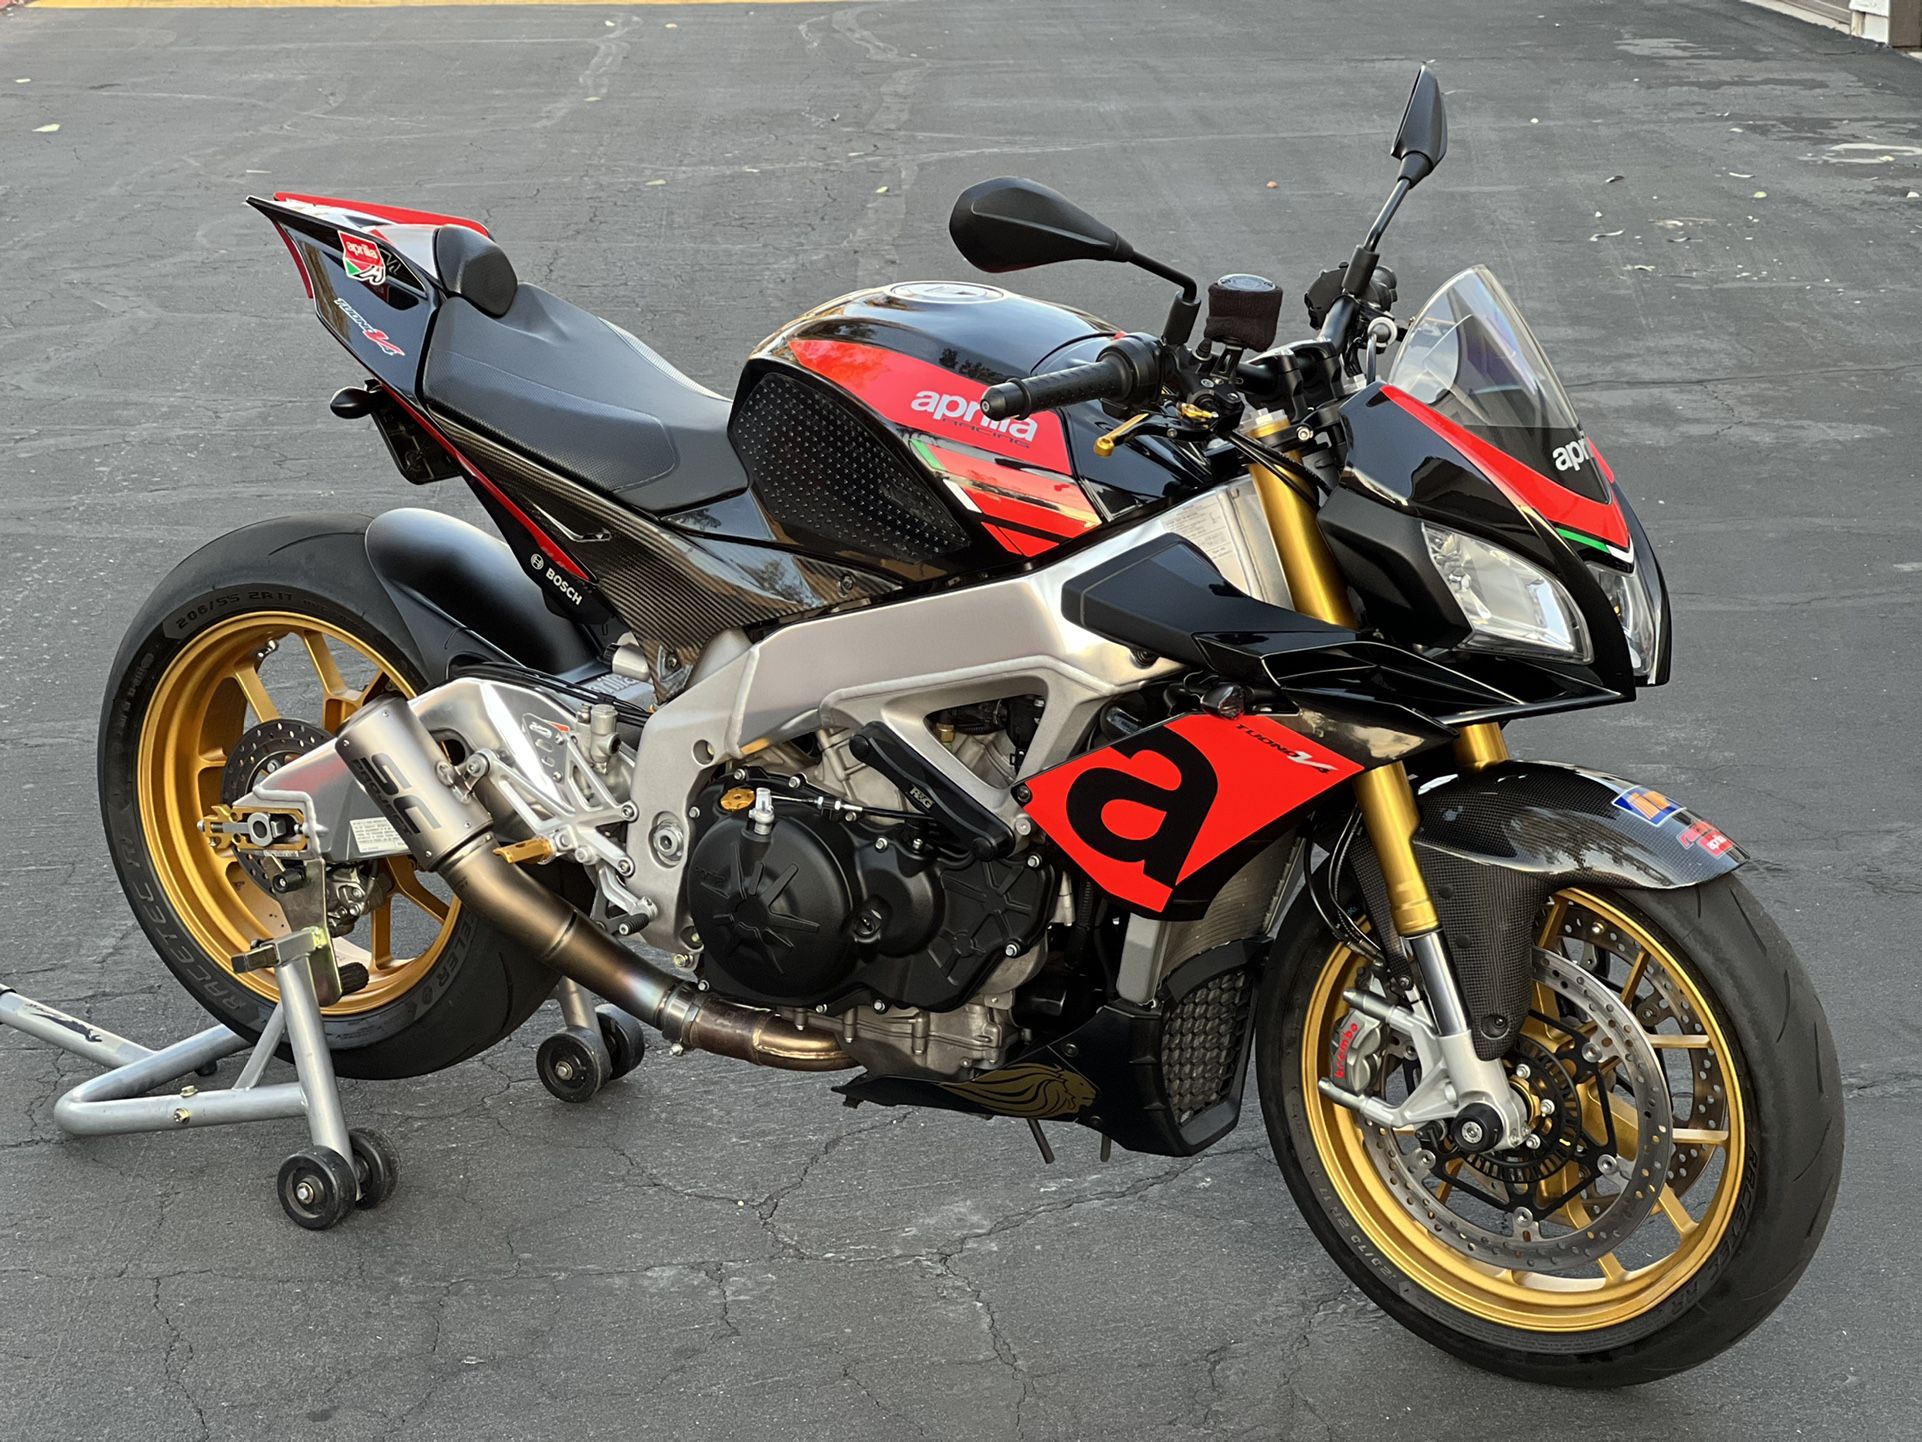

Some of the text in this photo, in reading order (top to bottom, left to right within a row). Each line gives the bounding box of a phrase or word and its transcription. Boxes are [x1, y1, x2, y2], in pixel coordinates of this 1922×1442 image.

[345, 241, 379, 260] aprilia
[545, 567, 582, 605] BOSCH
[131, 881, 246, 1011] RACETEC
[1333, 1022, 1359, 1079] brembo
